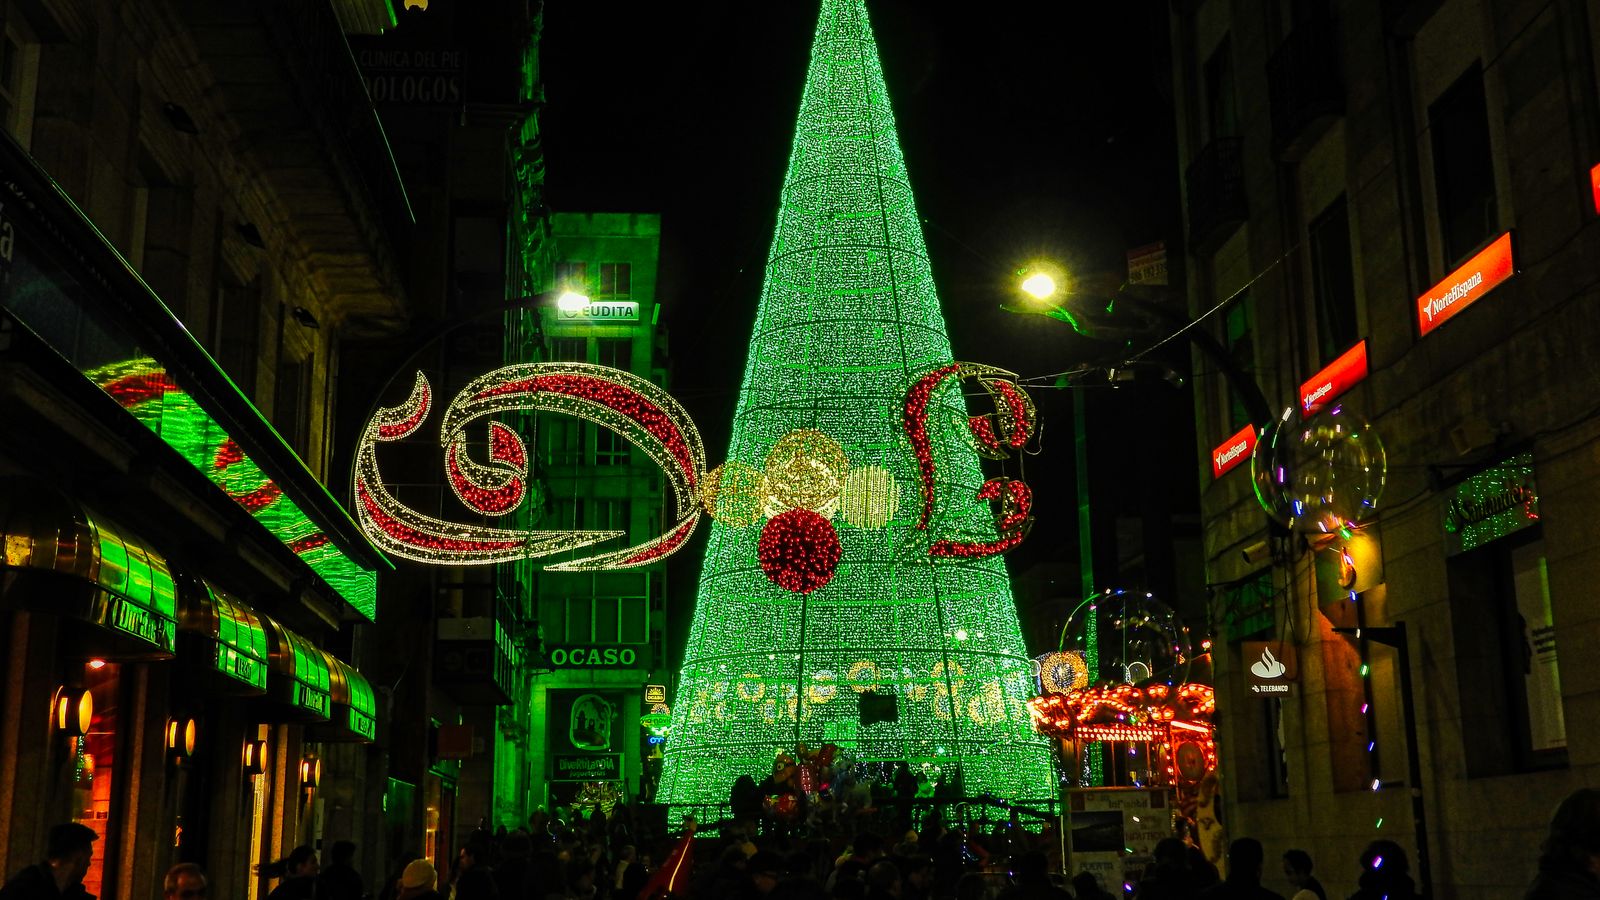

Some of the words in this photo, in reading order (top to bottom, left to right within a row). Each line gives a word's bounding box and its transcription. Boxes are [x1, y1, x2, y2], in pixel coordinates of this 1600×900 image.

[413, 50, 439, 68] DEL
[441, 51, 461, 69] PIE
[1433, 271, 1484, 316] NorteHispana
[583, 305, 634, 317] EUDITA
[551, 648, 636, 665] OCASO
[1260, 684, 1289, 692] TELEBANCO
